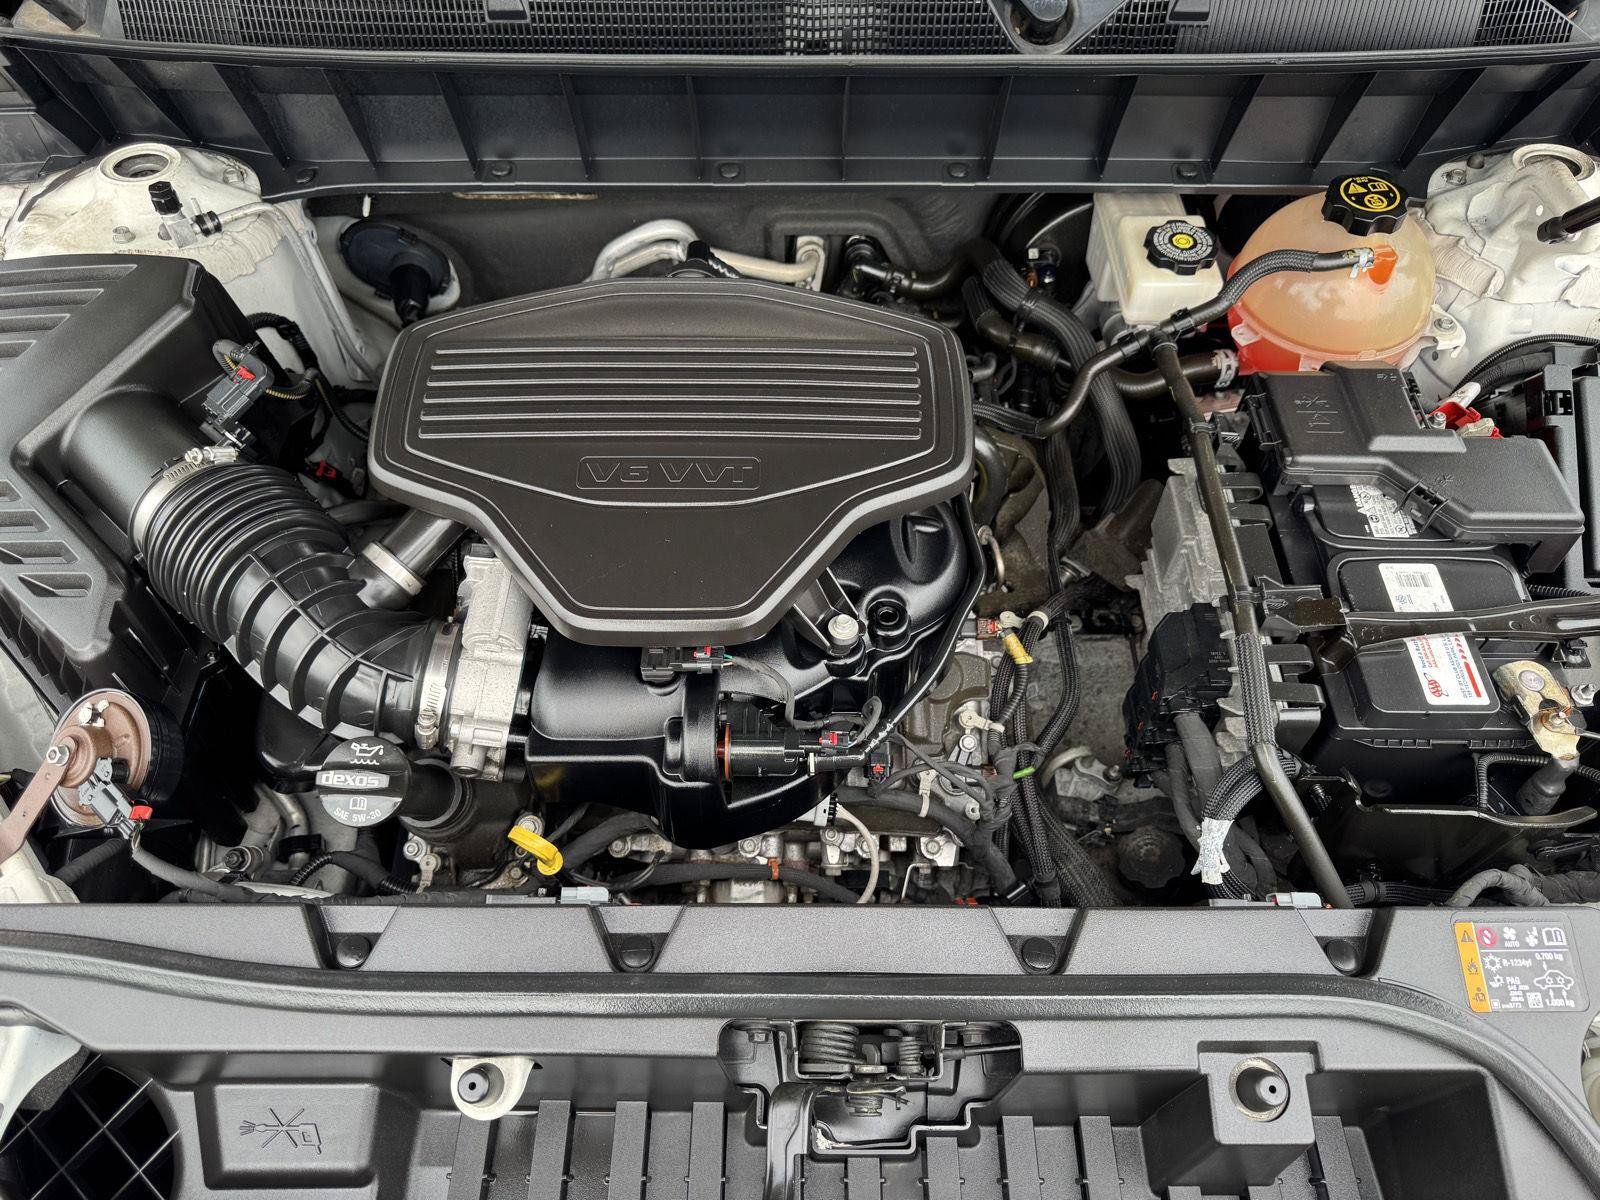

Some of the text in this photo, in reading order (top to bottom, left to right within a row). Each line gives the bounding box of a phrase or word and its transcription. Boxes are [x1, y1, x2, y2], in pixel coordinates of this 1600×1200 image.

[586, 462, 753, 483] V6 VVT
[321, 770, 380, 787] dexos
[333, 807, 382, 823] SAE 5W-30
